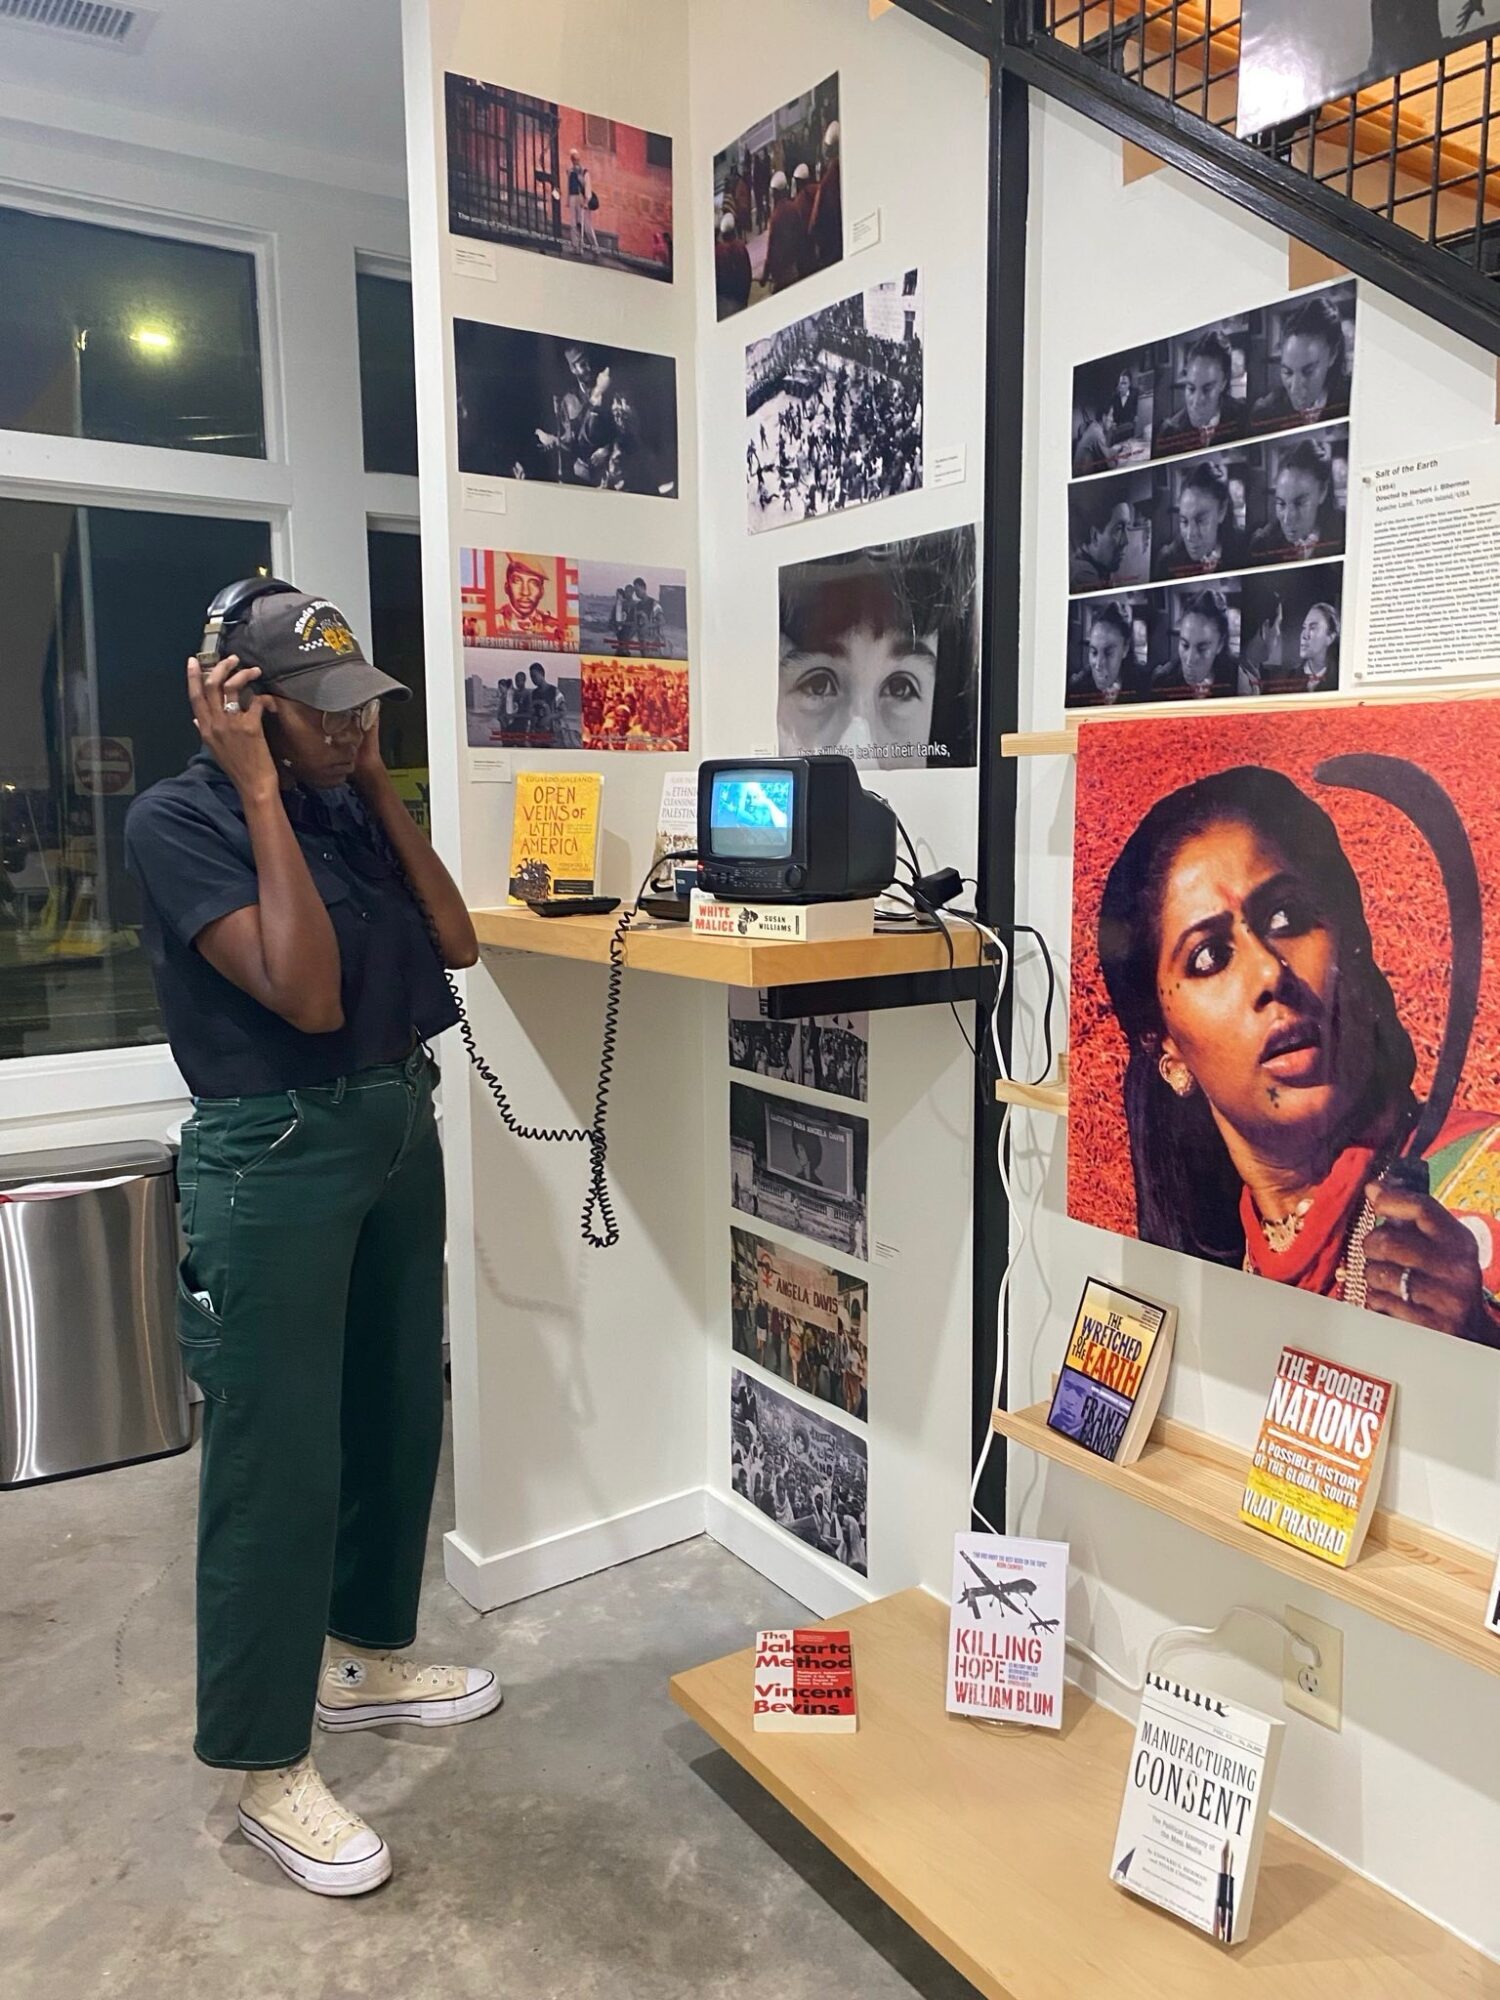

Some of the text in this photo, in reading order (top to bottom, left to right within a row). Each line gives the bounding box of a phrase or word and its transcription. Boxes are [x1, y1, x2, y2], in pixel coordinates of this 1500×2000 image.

[1375, 459, 1438, 478] Salt of the Earth
[856, 743, 889, 759] behind
[891, 743, 914, 758] their
[917, 741, 950, 758] tanks,
[534, 786, 576, 804] OPEN
[672, 786, 697, 797] ETHNI
[523, 805, 587, 821] VEINS OF
[661, 807, 696, 818] PALESTIN
[529, 822, 564, 836] LATIN
[520, 836, 578, 856] AMERICA
[699, 905, 730, 918] WHITE
[764, 915, 786, 923] SUSAN
[695, 918, 734, 932] MALICE
[759, 923, 791, 932] WILLIAMS
[776, 1277, 838, 1315] ANGELA DAVIS
[1107, 1312, 1124, 1330] THE
[1077, 1335, 1087, 1350] OF
[1081, 1315, 1142, 1362] WRETCHED
[1072, 1344, 1086, 1361] THE
[1081, 1341, 1142, 1398] EARTH
[1279, 1351, 1385, 1413] THE POORER
[1081, 1395, 1129, 1438] FRANTZ
[1265, 1377, 1379, 1460] NATIONS
[1258, 1438, 1362, 1491] A POSSIBLE HISTORY
[1254, 1454, 1266, 1468] OF
[1267, 1458, 1285, 1477] THE
[1285, 1466, 1320, 1494] GLOBAL
[1322, 1484, 1358, 1508] SOUTH
[1243, 1487, 1278, 1524] VIJAY
[1279, 1505, 1347, 1554] PRASHAD
[756, 1639, 851, 1654] Jakarta
[956, 1628, 1042, 1664] KILLING
[755, 1654, 852, 1669] Method
[955, 1655, 1006, 1683] HOPE
[755, 1683, 853, 1698] Vincent
[955, 1681, 1053, 1717] WILLIAM BLUM
[754, 1699, 840, 1714] Bevins
[1141, 1721, 1257, 1792] MANUFACTURING
[1134, 1750, 1251, 1836] CONSENT
